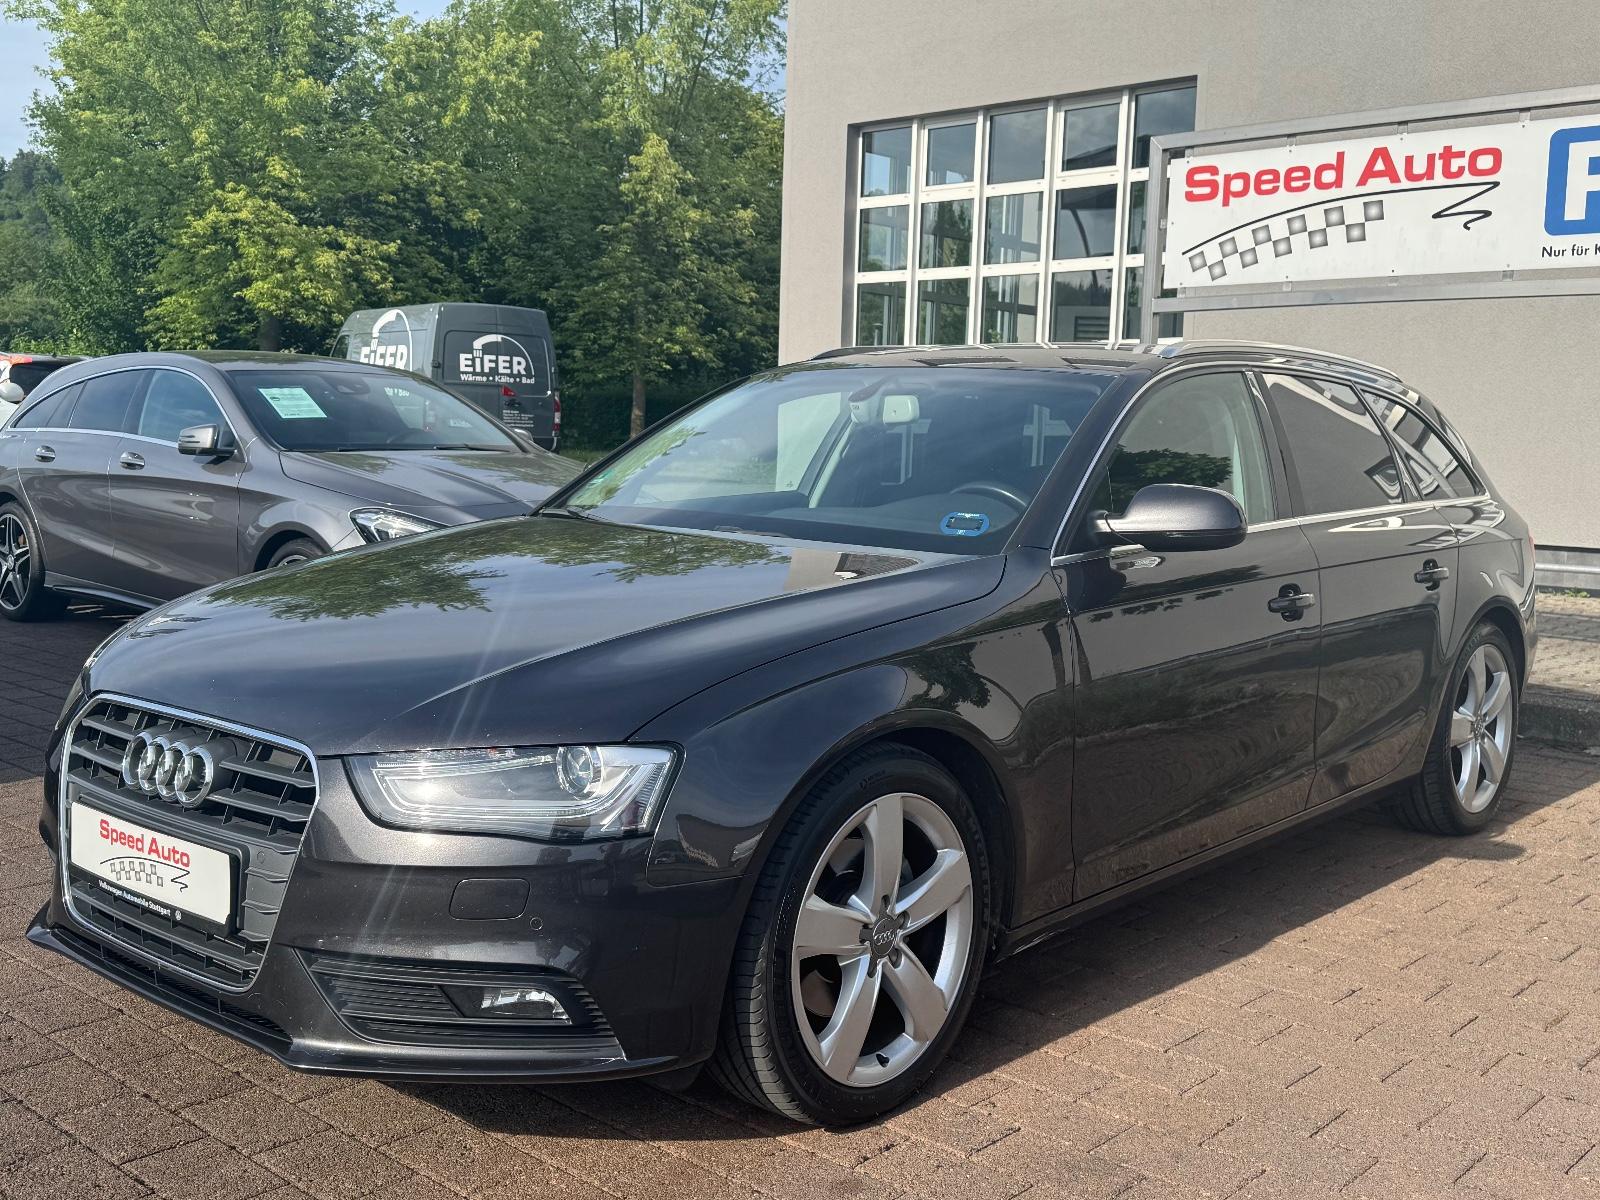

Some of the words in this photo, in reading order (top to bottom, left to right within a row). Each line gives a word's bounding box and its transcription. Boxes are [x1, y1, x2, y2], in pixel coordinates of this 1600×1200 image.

[1184, 151, 1346, 207] Speed
[1356, 144, 1503, 188] Auto
[1541, 246, 1567, 258] Nur
[1571, 244, 1590, 257] für
[460, 373, 487, 382] Wärme
[494, 375, 515, 384] Kälte
[522, 376, 535, 384] Bad
[99, 819, 144, 852] Speed
[148, 837, 190, 868] Auto
[148, 900, 171, 917] Stuttgart
